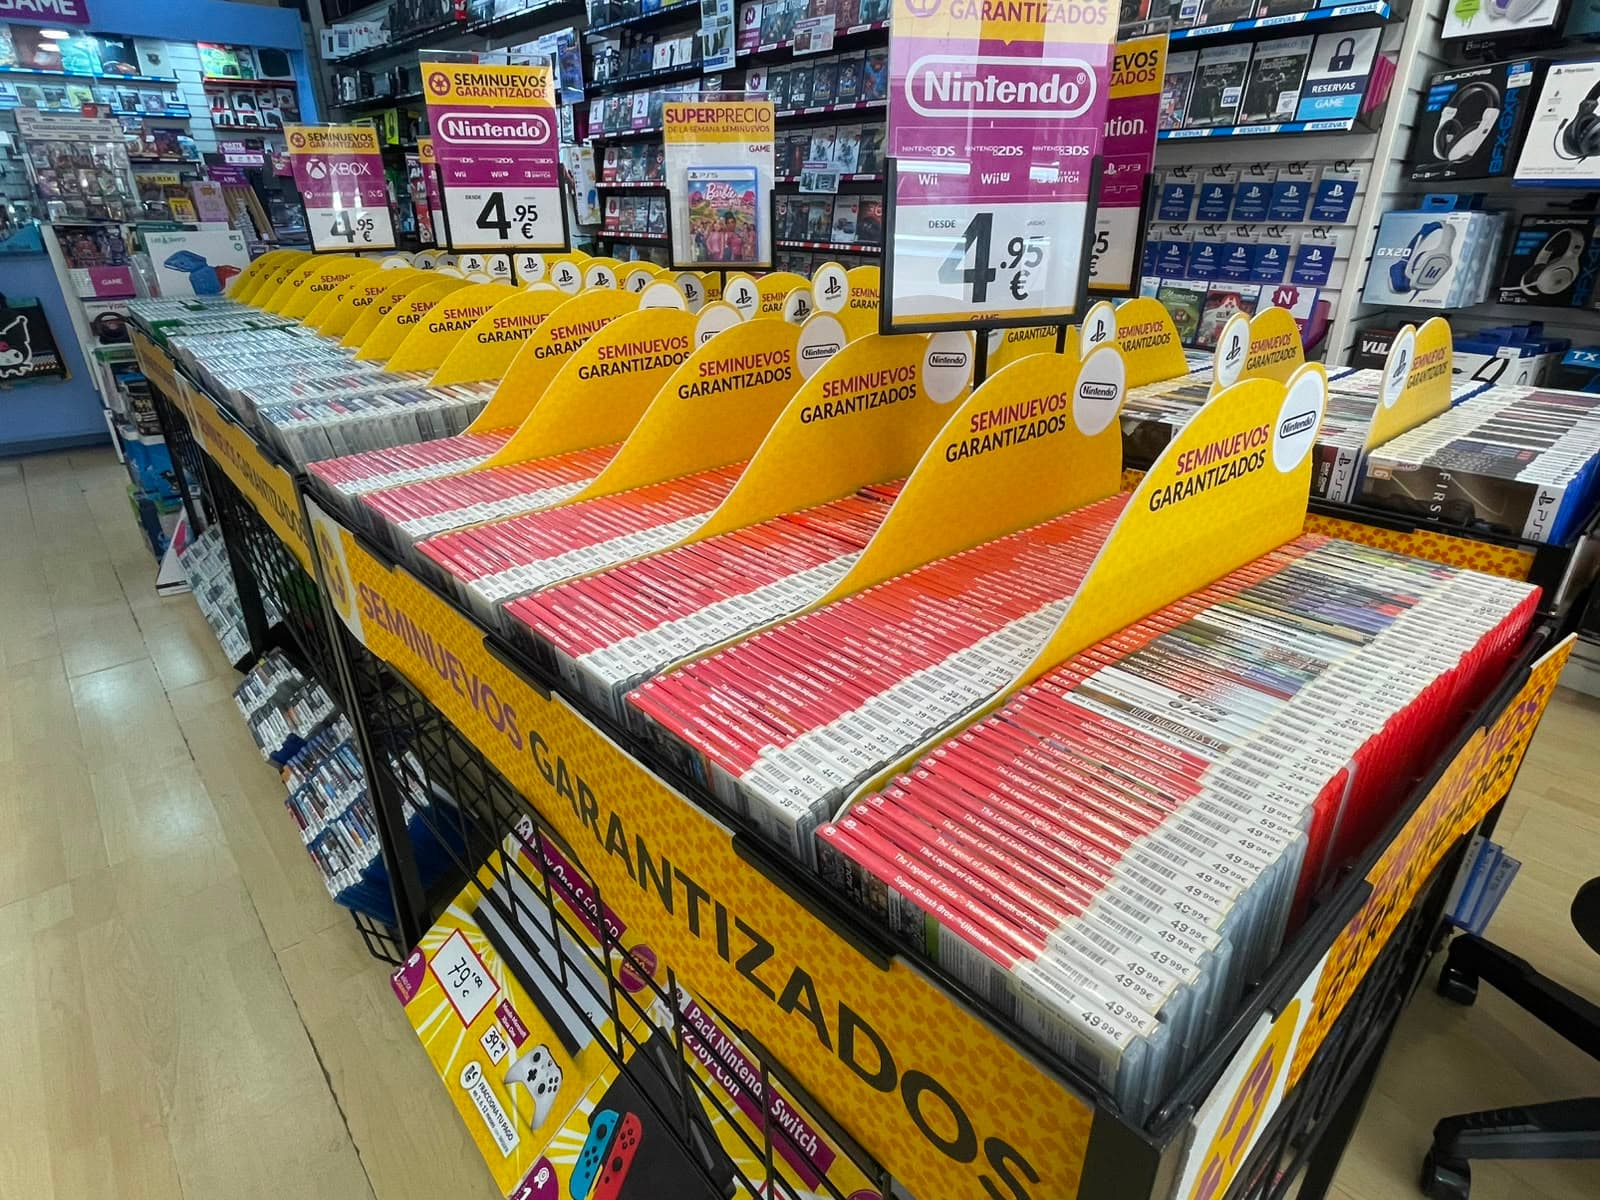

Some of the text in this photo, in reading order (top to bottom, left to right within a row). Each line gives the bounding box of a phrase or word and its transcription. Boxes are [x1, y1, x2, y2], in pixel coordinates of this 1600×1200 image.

[950, 0, 1108, 24] GARANTIZADOS
[1262, 16, 1296, 26] RESERVAS
[1193, 26, 1223, 35] RESERVAS
[454, 73, 546, 88] SEMINUEVOS
[1312, 82, 1355, 93] RESERVAS
[456, 87, 547, 98] GARANTIZADOS
[1315, 98, 1344, 108] GAME
[666, 108, 770, 123] SUPERPRECIO
[1311, 121, 1347, 129] RESERVAS
[307, 133, 373, 141] SEMINUEVOS
[1239, 126, 1270, 134] RESERVAS
[310, 141, 375, 149] GARANTIZADOS
[329, 163, 371, 175] XBOX
[919, 174, 938, 185] Wii
[705, 182, 736, 199] Barbie
[929, 219, 956, 228] DESDE
[1008, 326, 1057, 343] GARANTIZAD
[598, 335, 689, 361] SEMINUEVOS
[805, 347, 837, 357] Nintendo
[578, 351, 690, 380] GARANTIZADOS
[698, 349, 791, 377] SEMINUEVOS
[931, 355, 965, 366] Nintendo
[1246, 347, 1298, 371] GARANTIZADOS
[678, 366, 793, 400] GARANTIZADOS
[822, 364, 917, 399] SEMINUEVOS
[1082, 385, 1116, 397] Nintendo
[800, 383, 917, 424] GARANTIZADOS
[970, 391, 1068, 434] SEMINUEVOS
[1281, 415, 1314, 435] Nintendo
[945, 413, 1067, 463] GARANTIZADOS
[1175, 423, 1271, 477] SEMINUEVOS
[1149, 448, 1267, 512] GARANTIZADOS
[358, 581, 523, 752] SEMINUEVOS
[895, 853, 908, 866] The
[906, 861, 933, 883] Legend
[930, 876, 942, 888] of
[920, 846, 932, 859] The
[931, 854, 958, 875] Legend
[894, 875, 915, 894] Super
[914, 886, 938, 910] Smash
[529, 730, 1041, 1200] GARANTIZADOS
[688, 1006, 818, 1157] Pack Nintend Switch
[478, 1081, 500, 1118] FRACCIONA
[501, 1120, 514, 1142] PAGO
